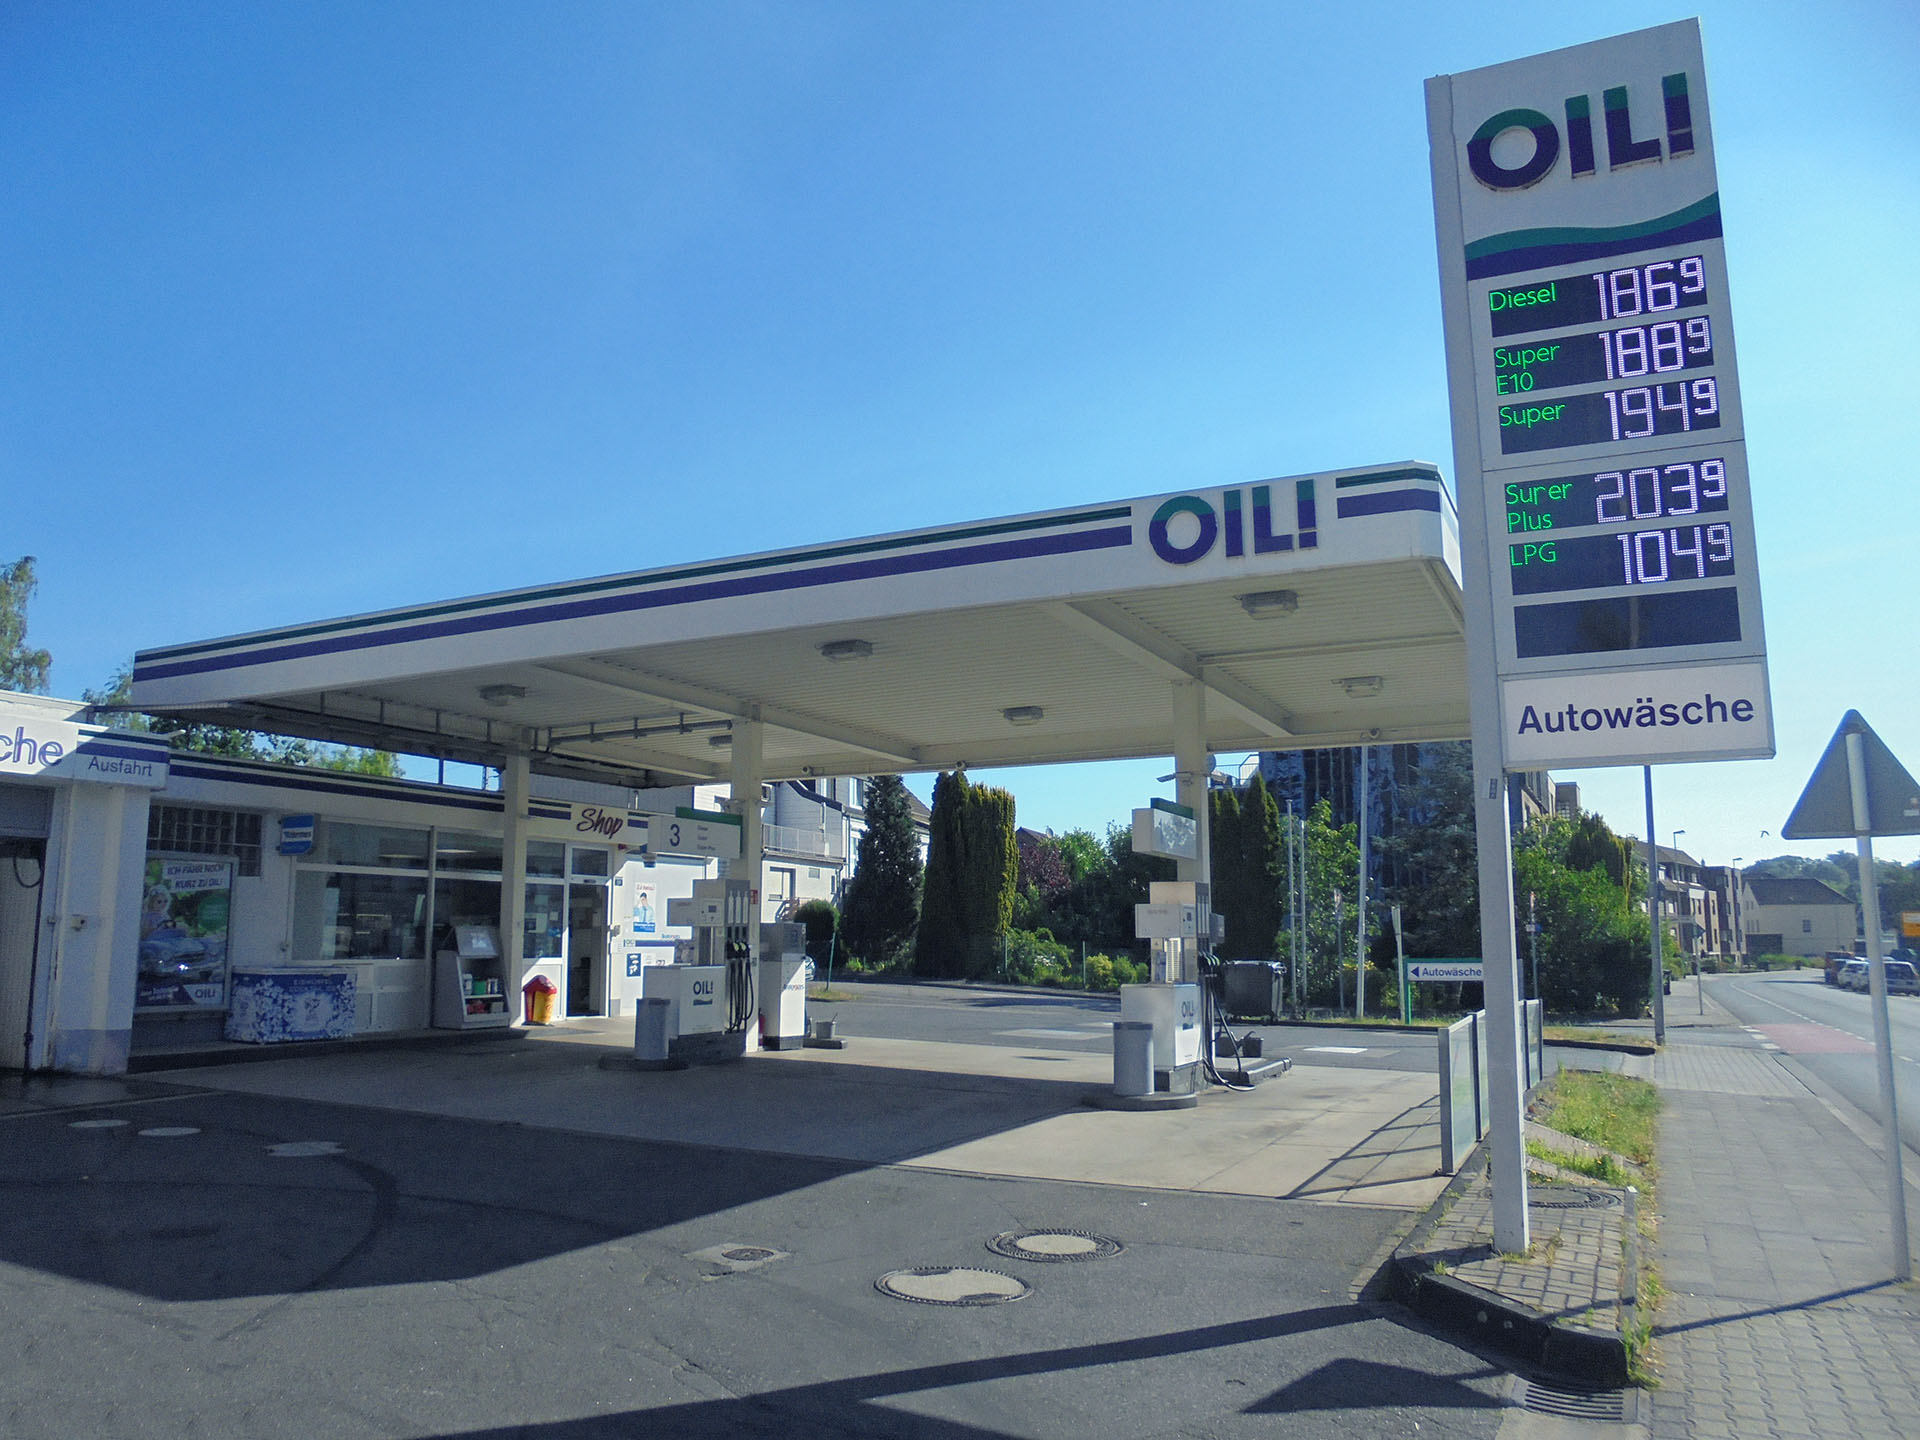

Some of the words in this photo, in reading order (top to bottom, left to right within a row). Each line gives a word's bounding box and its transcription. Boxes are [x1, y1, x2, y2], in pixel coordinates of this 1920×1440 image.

[1467, 72, 1695, 191] OIL!
[1489, 283, 1556, 312] Diesel
[1495, 344, 1560, 369] Super
[1496, 372, 1534, 395] E10
[1500, 403, 1565, 428] Super
[1149, 479, 1318, 565] OIL!
[1508, 511, 1552, 533] Plus
[1510, 542, 1557, 566] LPG
[1518, 694, 1754, 734] Autowäsche
[88, 756, 152, 777] Ausfahrt
[576, 808, 624, 840] Shop
[669, 824, 680, 847] 3
[1422, 966, 1482, 976] Autowäsche
[693, 981, 714, 995] OIL!
